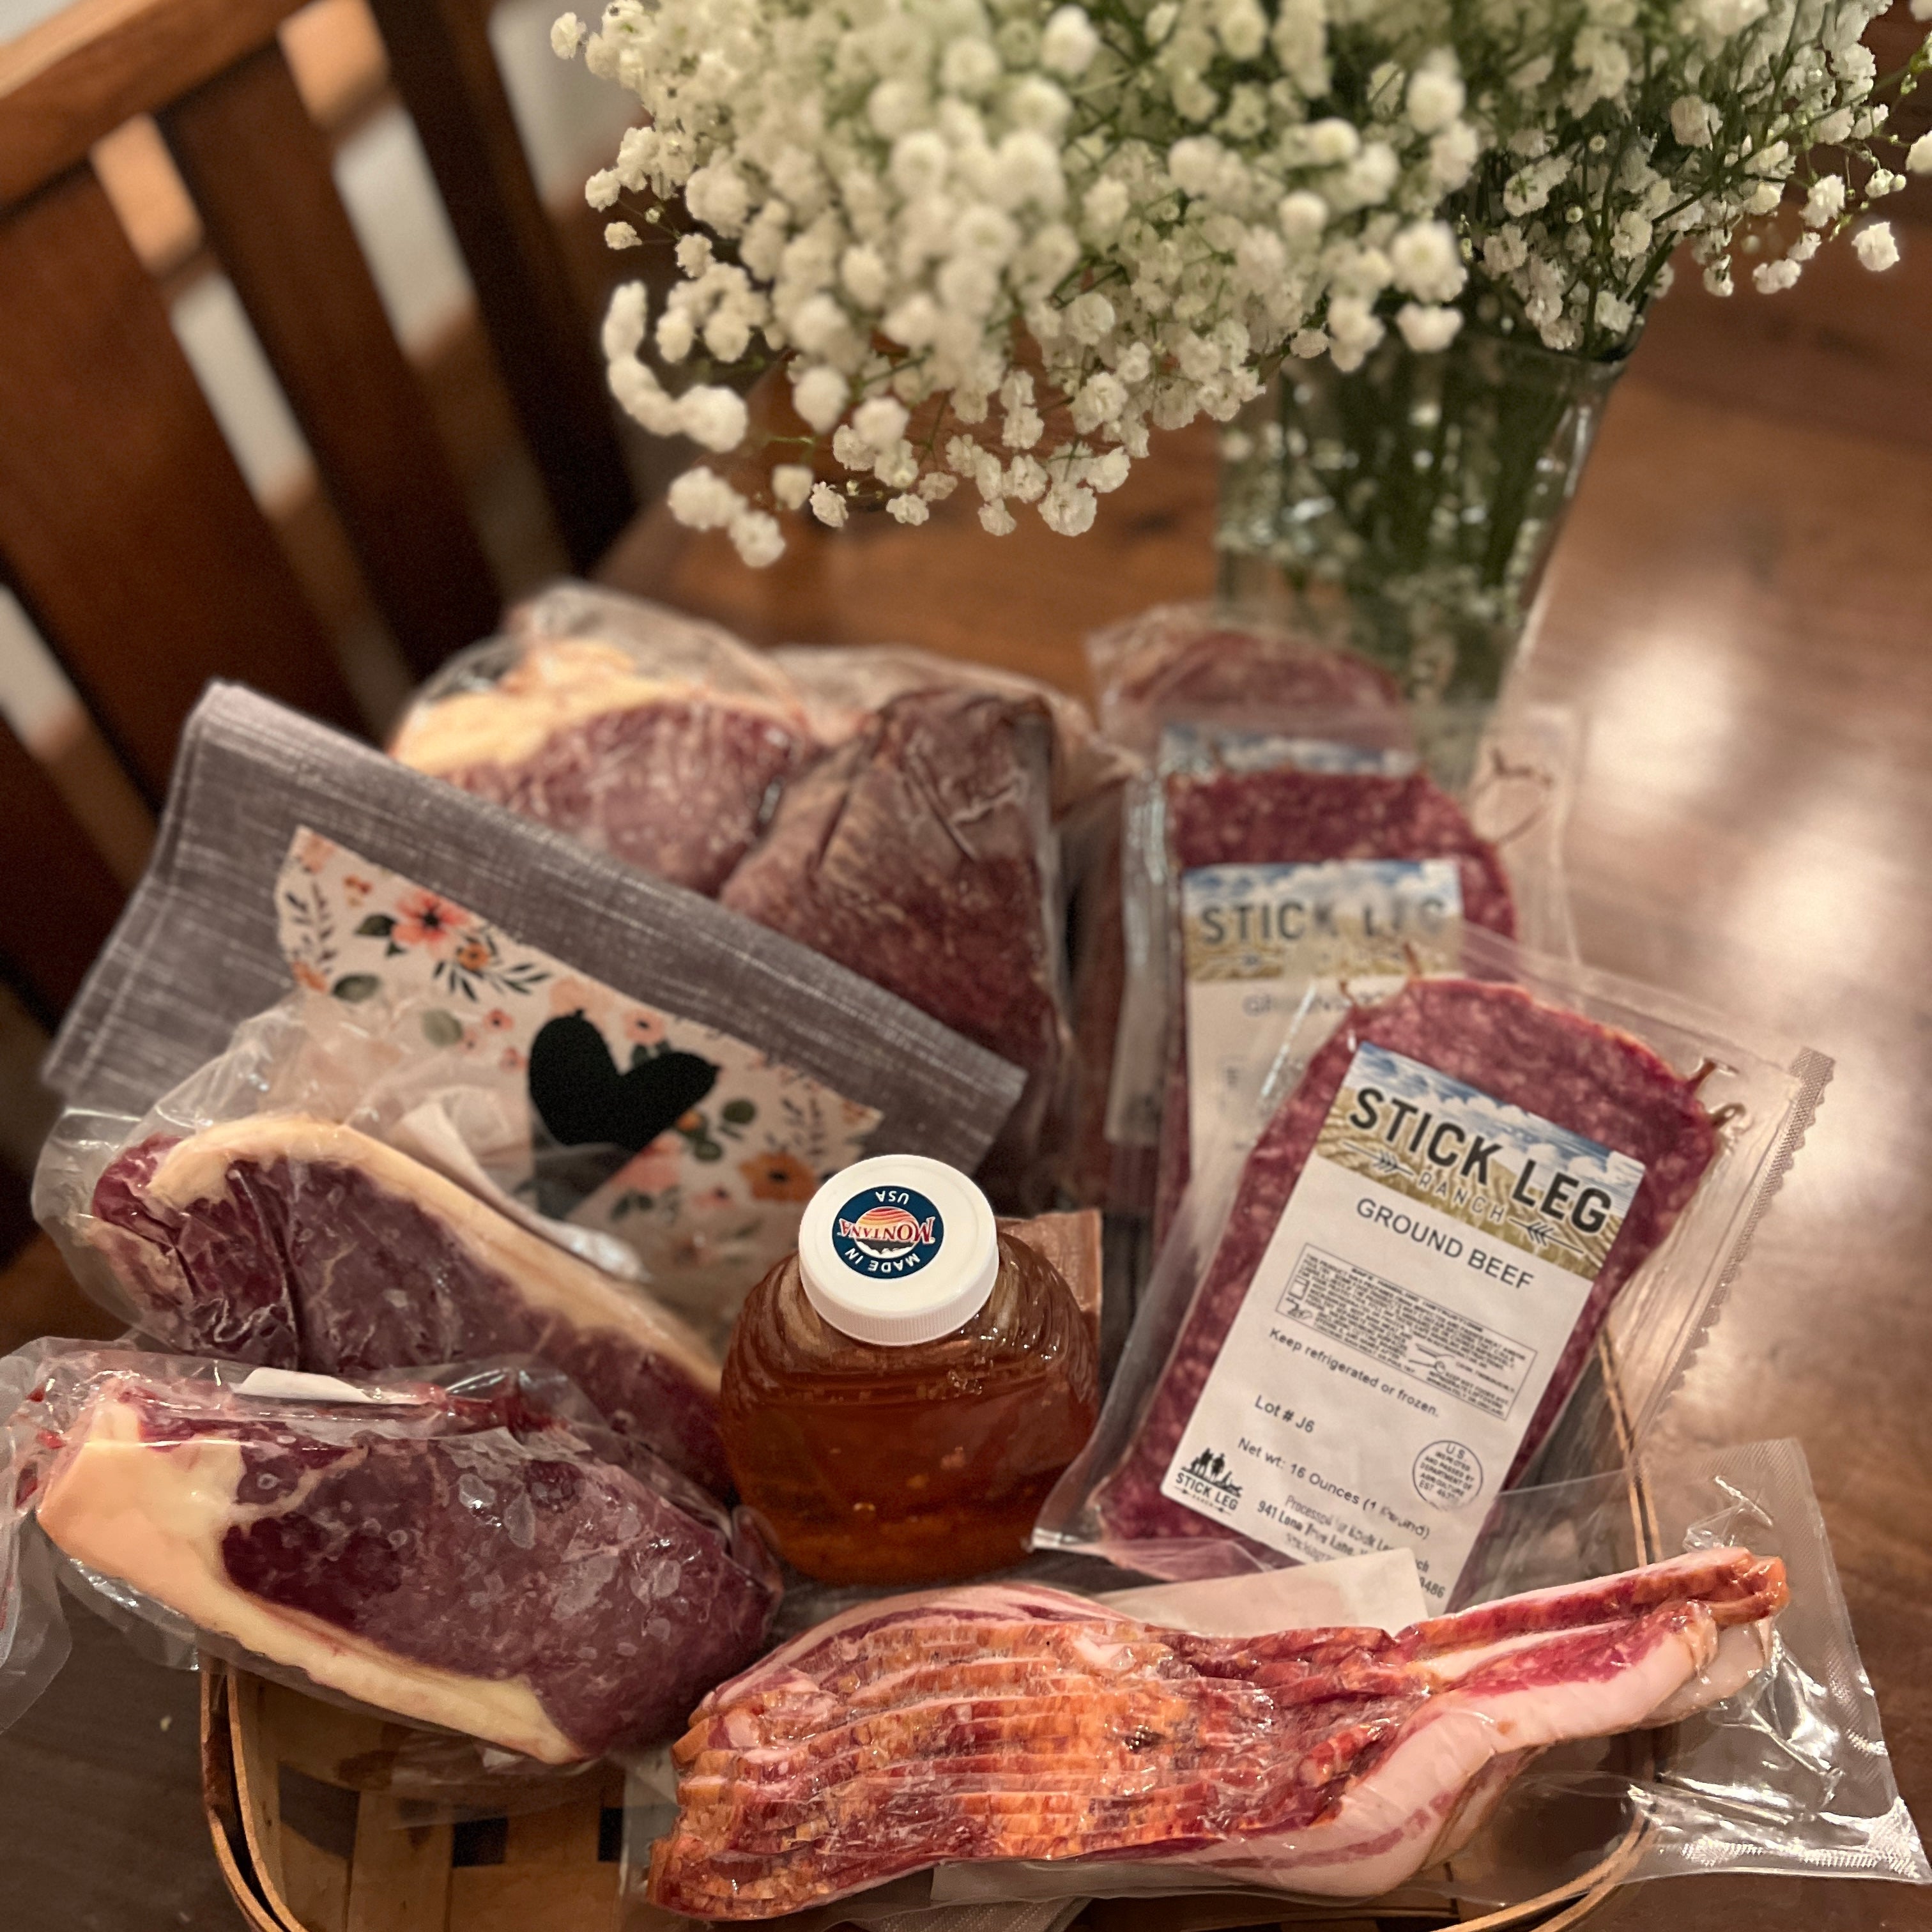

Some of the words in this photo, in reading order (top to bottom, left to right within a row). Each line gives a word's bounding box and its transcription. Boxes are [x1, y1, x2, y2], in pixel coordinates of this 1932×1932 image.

[1349, 1087, 1503, 1186] STICK
[1511, 1158, 1612, 1234] LEG
[875, 1190, 909, 1205] USA
[1418, 1171, 1506, 1222] RANCH
[839, 1216, 936, 1245] MONTANA
[1356, 1197, 1463, 1259] GROUND
[1469, 1248, 1534, 1290] BEEF
[845, 1247, 864, 1266] IN
[868, 1253, 921, 1273] MADE
[1269, 1327, 1302, 1353] Keep
[1305, 1346, 1379, 1388] refrigerated
[1381, 1382, 1396, 1396] or
[1397, 1389, 1439, 1418] frozen.
[1254, 1395, 1281, 1418] Lot
[1282, 1409, 1294, 1422] #
[1296, 1416, 1315, 1434] J6
[1238, 1437, 1262, 1458] Net
[1265, 1452, 1285, 1469] wt:
[1291, 1462, 1307, 1479] 16
[1309, 1472, 1360, 1505] Ounces
[1363, 1498, 1377, 1511] (1
[1420, 1462, 1463, 1485] DEPARTMENT
[1463, 1482, 1473, 1491] OF
[1420, 1472, 1464, 1497] AGRICULTURE
[1439, 1462, 1464, 1478] PASSED
[1175, 1472, 1213, 1499] STICK
[1215, 1491, 1239, 1512] LEG
[1257, 1499, 1278, 1519] 941
